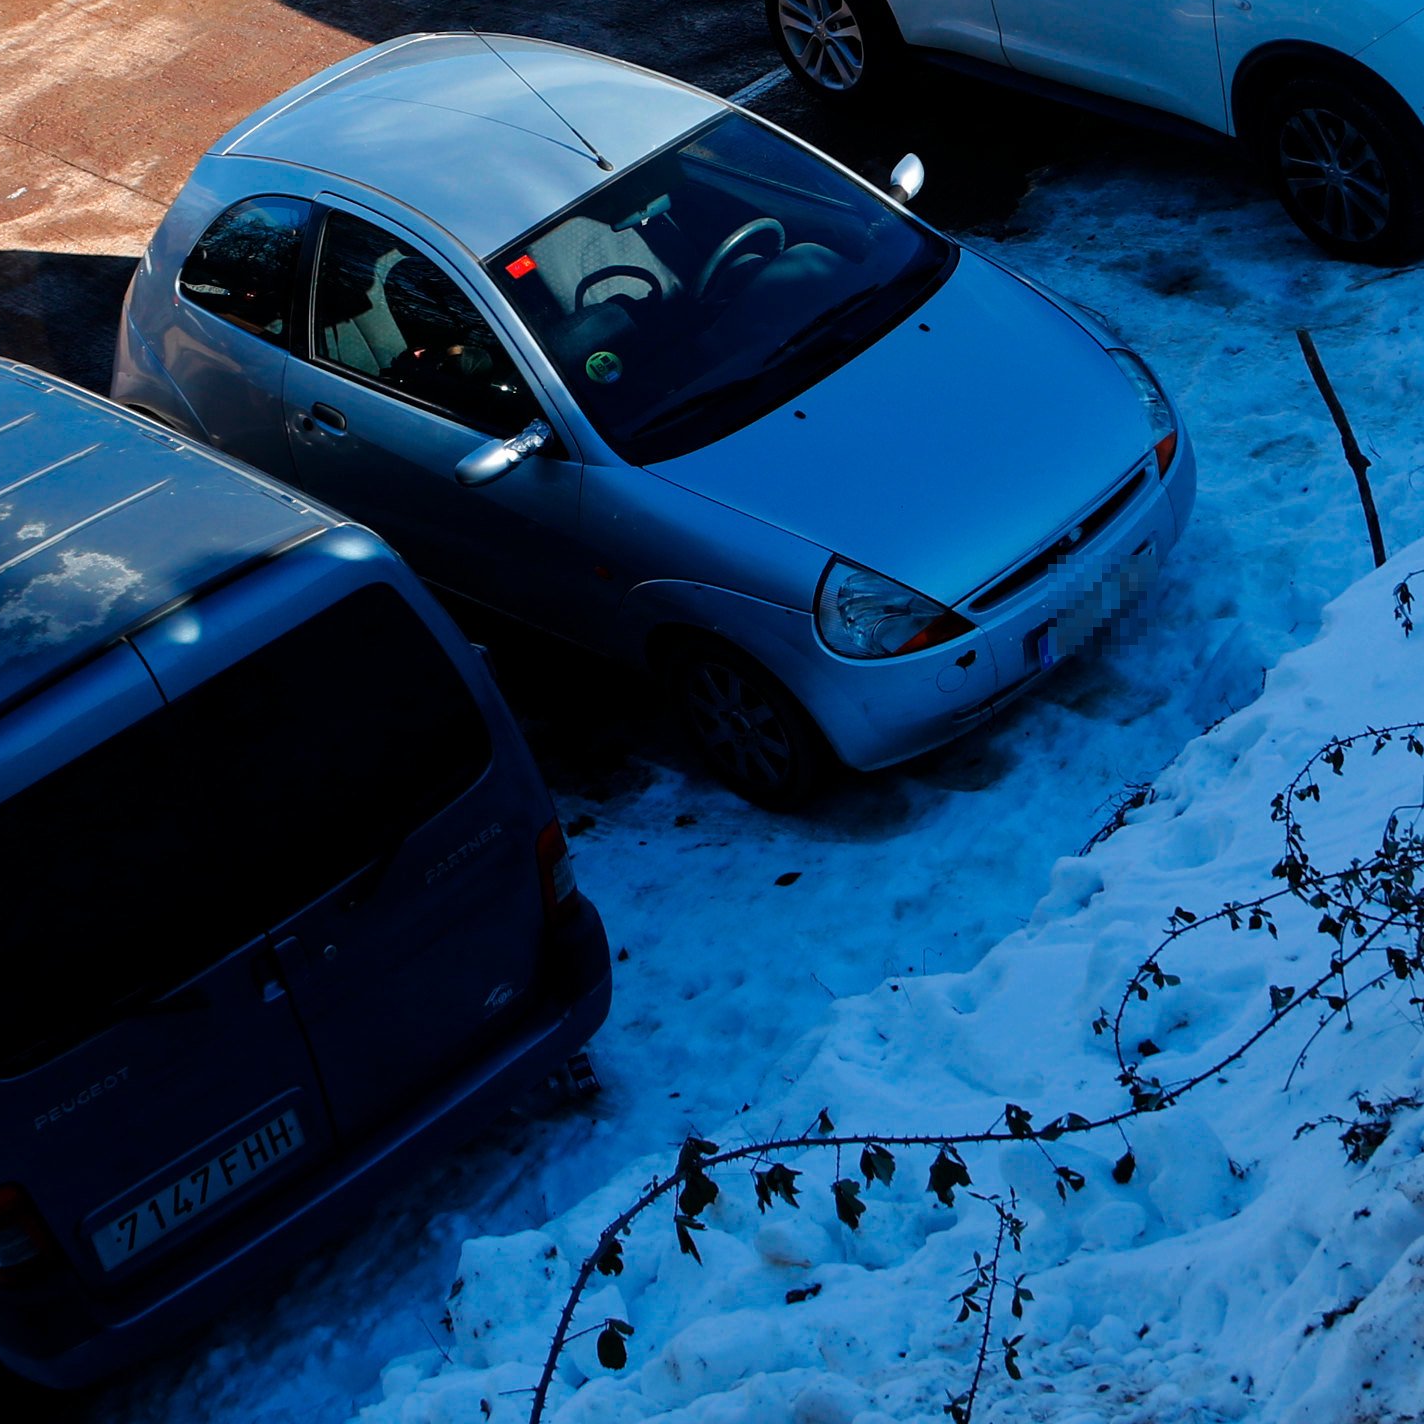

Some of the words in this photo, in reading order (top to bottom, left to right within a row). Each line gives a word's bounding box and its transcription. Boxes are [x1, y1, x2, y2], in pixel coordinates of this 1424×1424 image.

[33, 1065, 129, 1131] PEUGEOT
[118, 1167, 211, 1251] 7147
[218, 1117, 293, 1186] FHH
